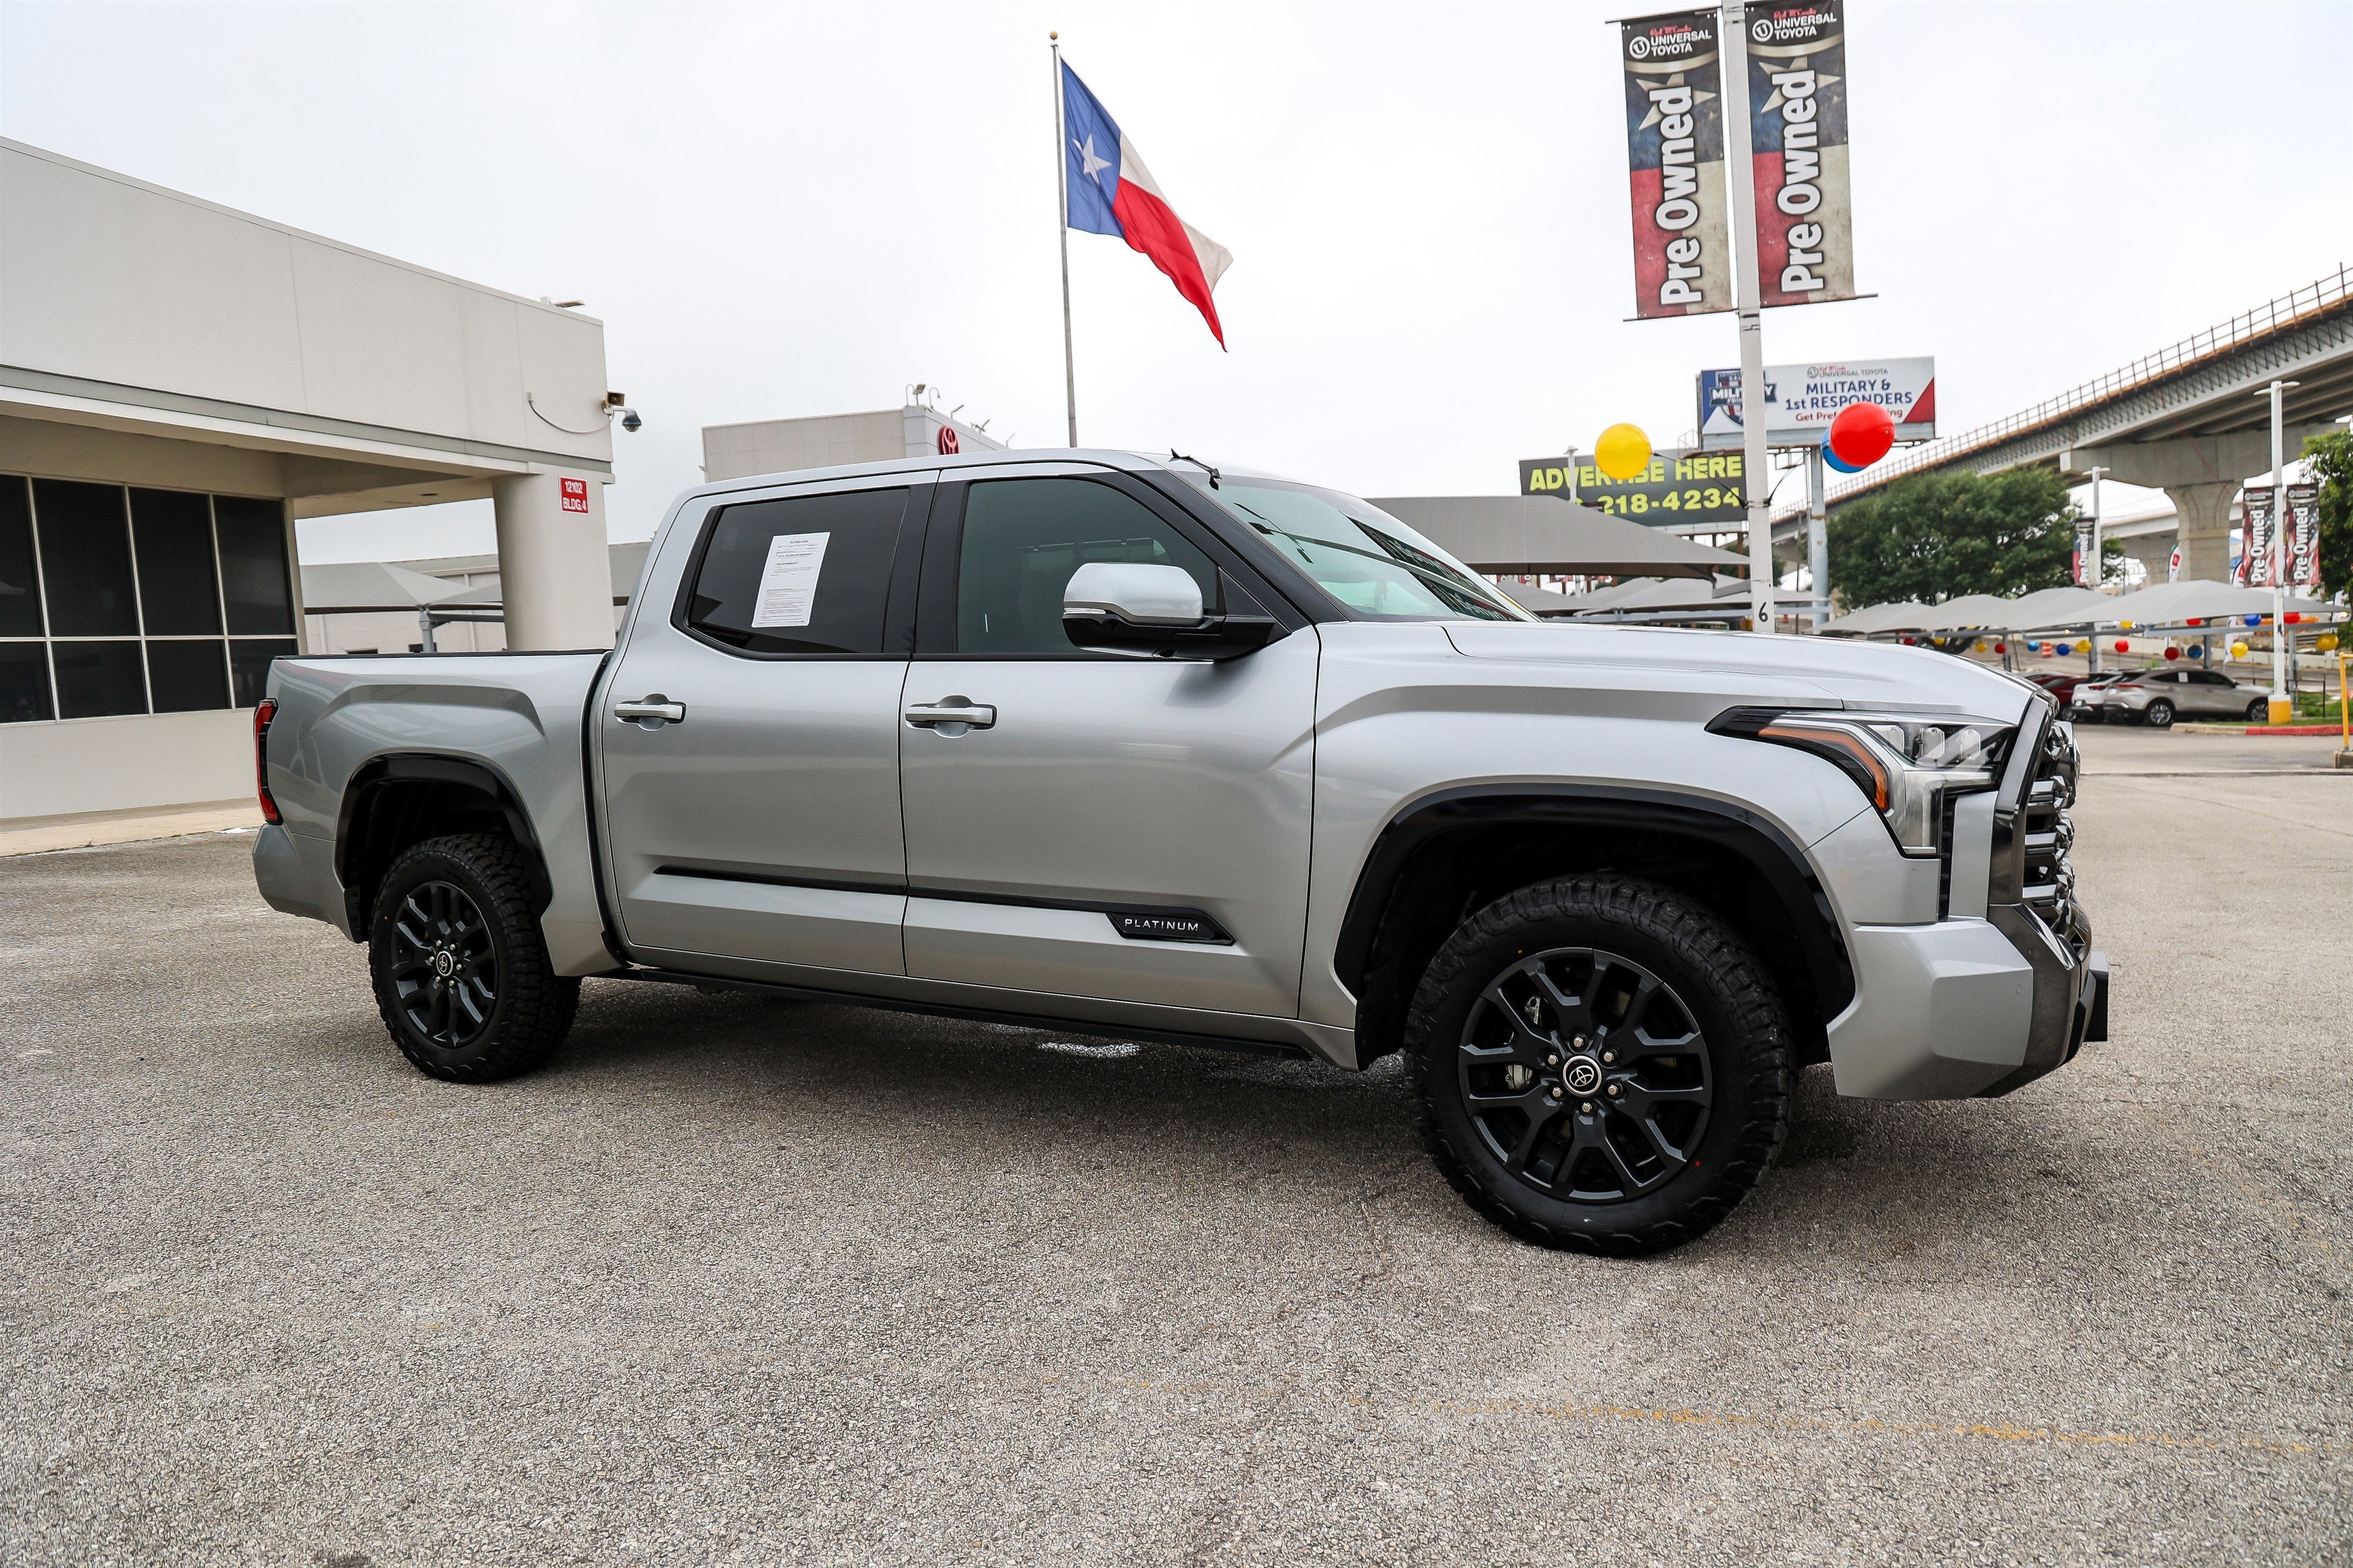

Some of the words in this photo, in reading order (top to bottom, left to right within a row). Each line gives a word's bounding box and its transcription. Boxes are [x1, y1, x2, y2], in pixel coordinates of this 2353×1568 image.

[1773, 12, 1837, 29] UNIVERSAL
[1650, 29, 1712, 46] UNIVERSAL
[1774, 25, 1817, 41] TOYOTA
[1651, 43, 1693, 57] TOYOTA
[1772, 69, 1821, 215] Owned
[1649, 86, 1699, 230] Owned
[1781, 223, 1824, 293] Pre
[1660, 237, 1702, 305] Pre
[1712, 385, 1773, 400] MILIY
[1807, 379, 1877, 395] MILITARY
[1881, 379, 1891, 391] &
[1786, 397, 1807, 410] 1st
[1811, 392, 1912, 408] RESPONDERS
[1796, 412, 1814, 421] Get
[1529, 461, 1665, 491] ADVERSE
[1675, 455, 1742, 481] HERE
[565, 480, 584, 494] 12102
[1597, 487, 1741, 515] 218-4234
[2249, 509, 2265, 557] Owned
[2293, 507, 2309, 555] Owned
[2250, 558, 2266, 582] Pre
[2294, 556, 2309, 580] Pre
[1759, 601, 1768, 622] 6
[1125, 918, 1198, 931] PLATINUM
